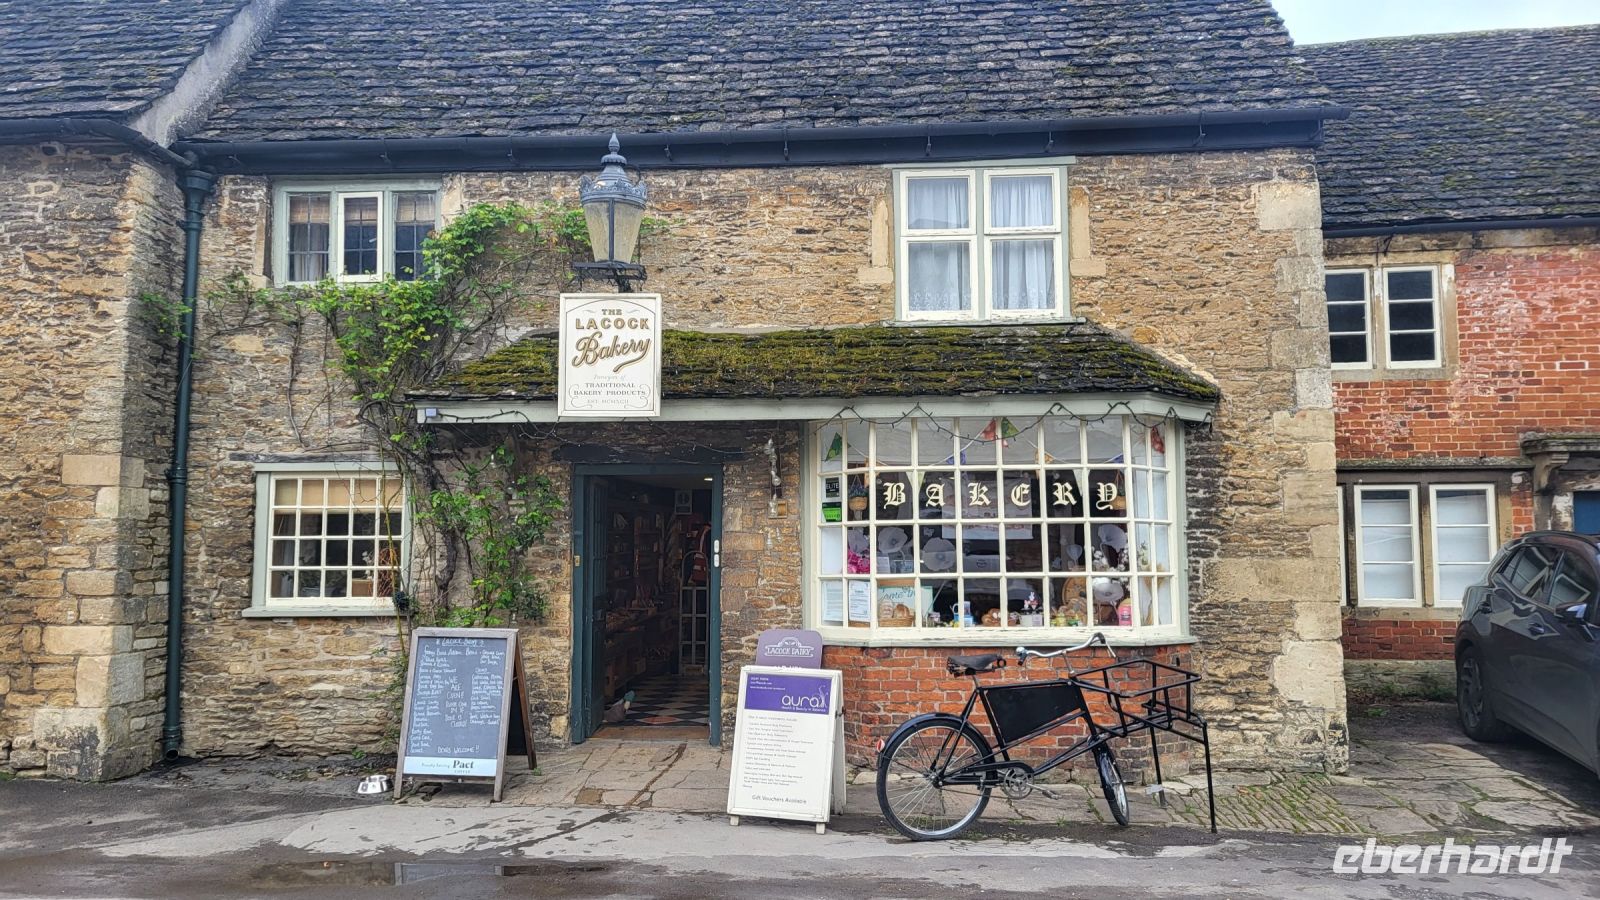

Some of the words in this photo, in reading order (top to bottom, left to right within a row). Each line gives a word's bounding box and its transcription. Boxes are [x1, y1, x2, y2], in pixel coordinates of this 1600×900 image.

[575, 317, 650, 330] LACOCK
[571, 331, 651, 373] Bakery
[883, 482, 1118, 510] BAKERY
[767, 647, 790, 655] LACOCK
[791, 647, 811, 656] DAIRY
[781, 695, 819, 708] aura
[437, 746, 452, 754] DOGS
[452, 759, 474, 769] Pact
